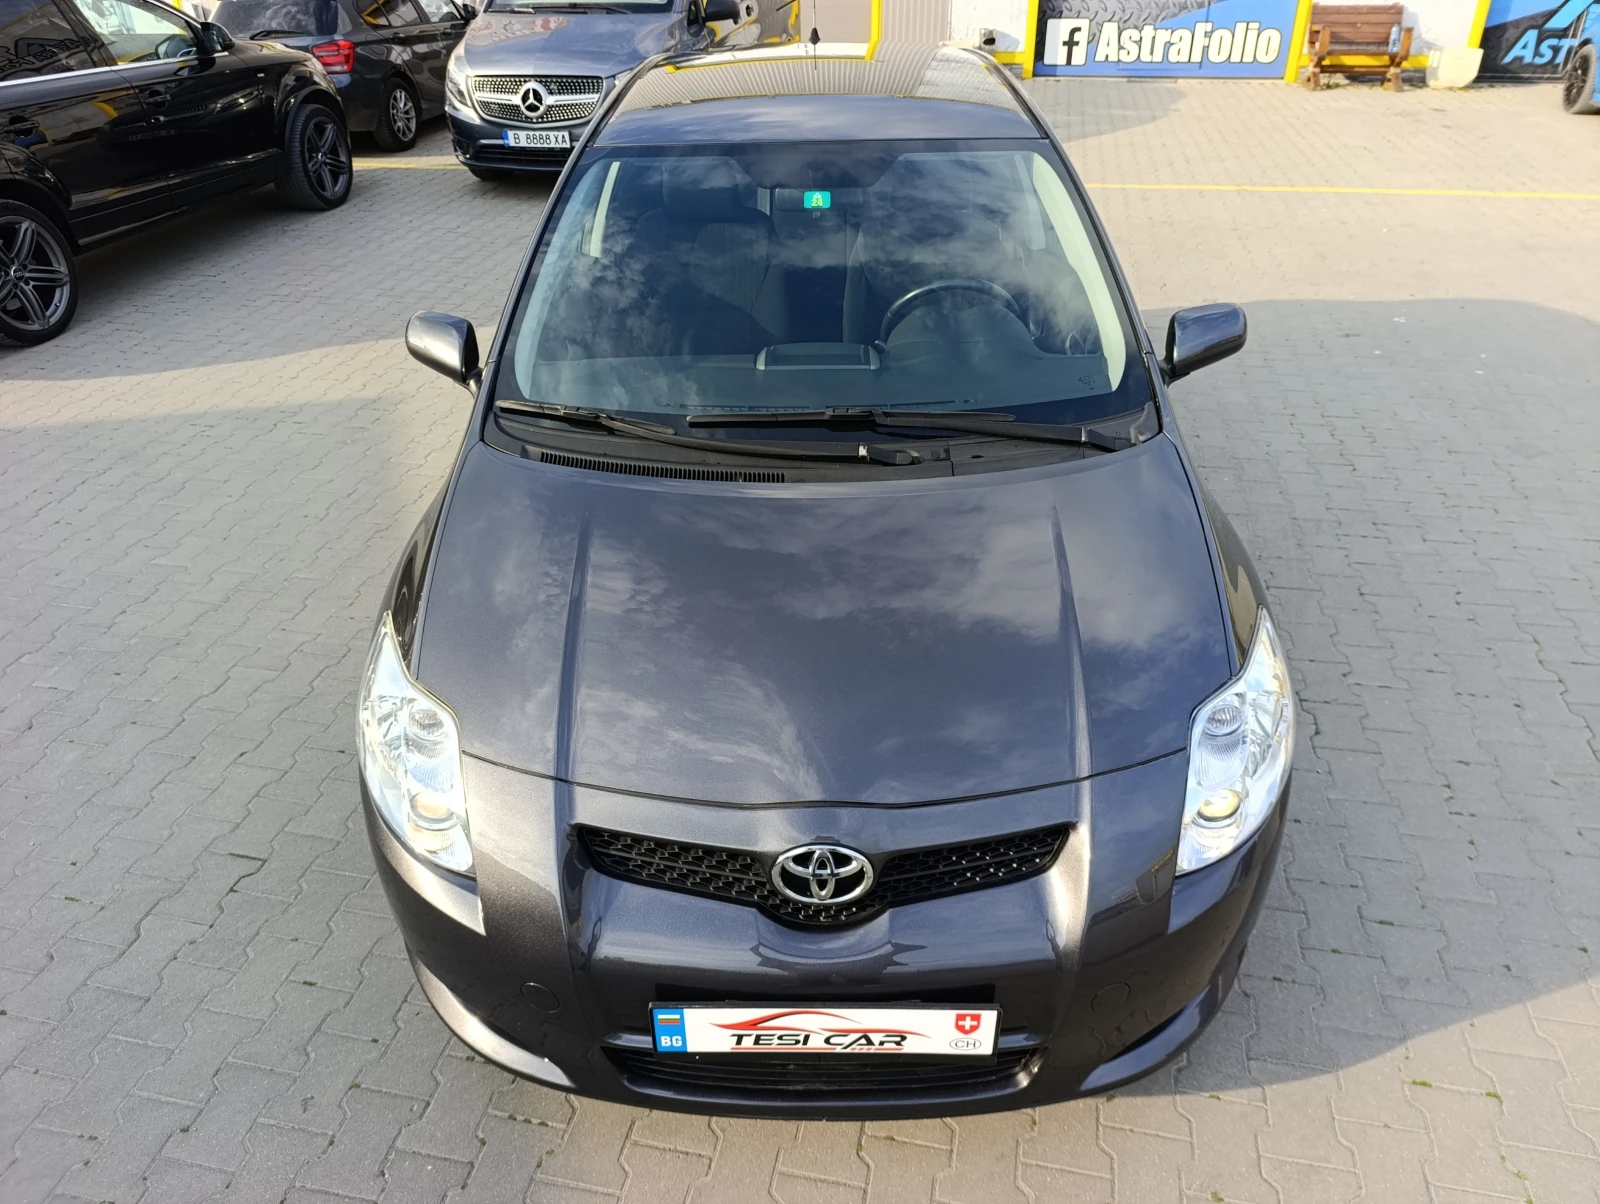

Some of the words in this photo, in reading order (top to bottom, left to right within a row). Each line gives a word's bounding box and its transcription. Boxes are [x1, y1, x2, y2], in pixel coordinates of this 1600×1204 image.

[1093, 21, 1282, 64] AstraFolio
[513, 132, 521, 145] B
[525, 133, 551, 145] 8888
[553, 133, 567, 145] XA
[660, 1035, 683, 1047] BG
[729, 1033, 810, 1046] TESI
[823, 1033, 907, 1050] CAR
[954, 1039, 976, 1049] CH
